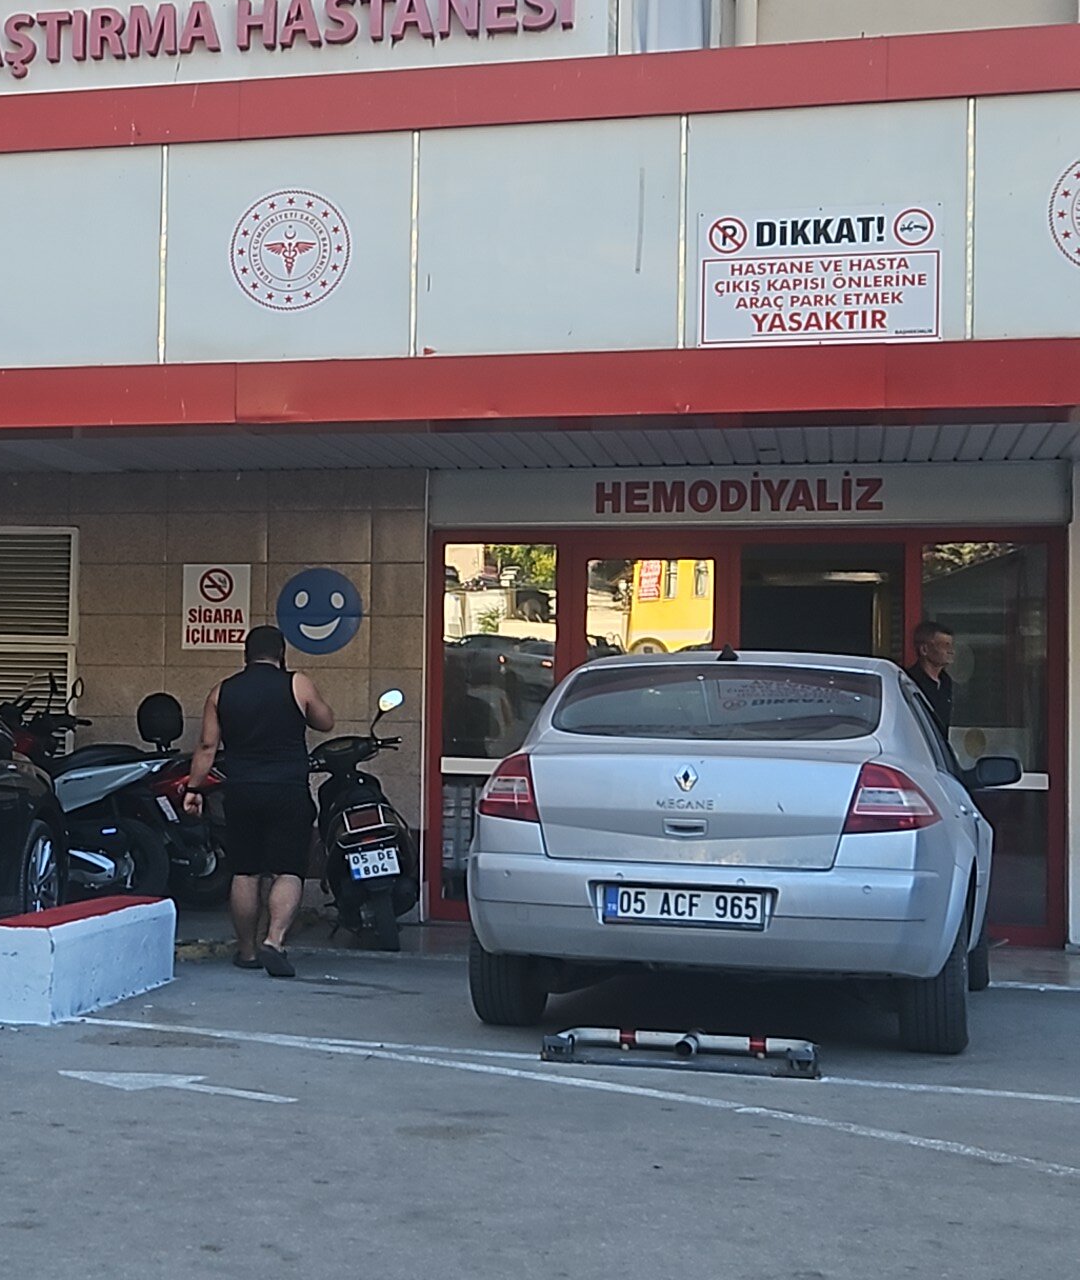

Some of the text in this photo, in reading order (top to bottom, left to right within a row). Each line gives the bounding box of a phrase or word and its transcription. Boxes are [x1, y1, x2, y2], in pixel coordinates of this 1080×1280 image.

[730, 256, 910, 277] HASTANE VE HASTA
[714, 270, 927, 297] ÇIKIŞ KAPISI ÖNLERİNE
[735, 291, 903, 311] ARAÇ PARK ETMEK
[751, 309, 887, 333] YASAKTIR
[595, 470, 884, 513] HEMODİYALİZ
[188, 605, 244, 624] SİGARA
[185, 625, 246, 645] İÇİLMEZ
[656, 798, 714, 811] MEGANE
[352, 850, 395, 865] 05 DE
[620, 890, 647, 915] 05
[660, 892, 701, 917] ACF
[715, 895, 758, 920] 965
